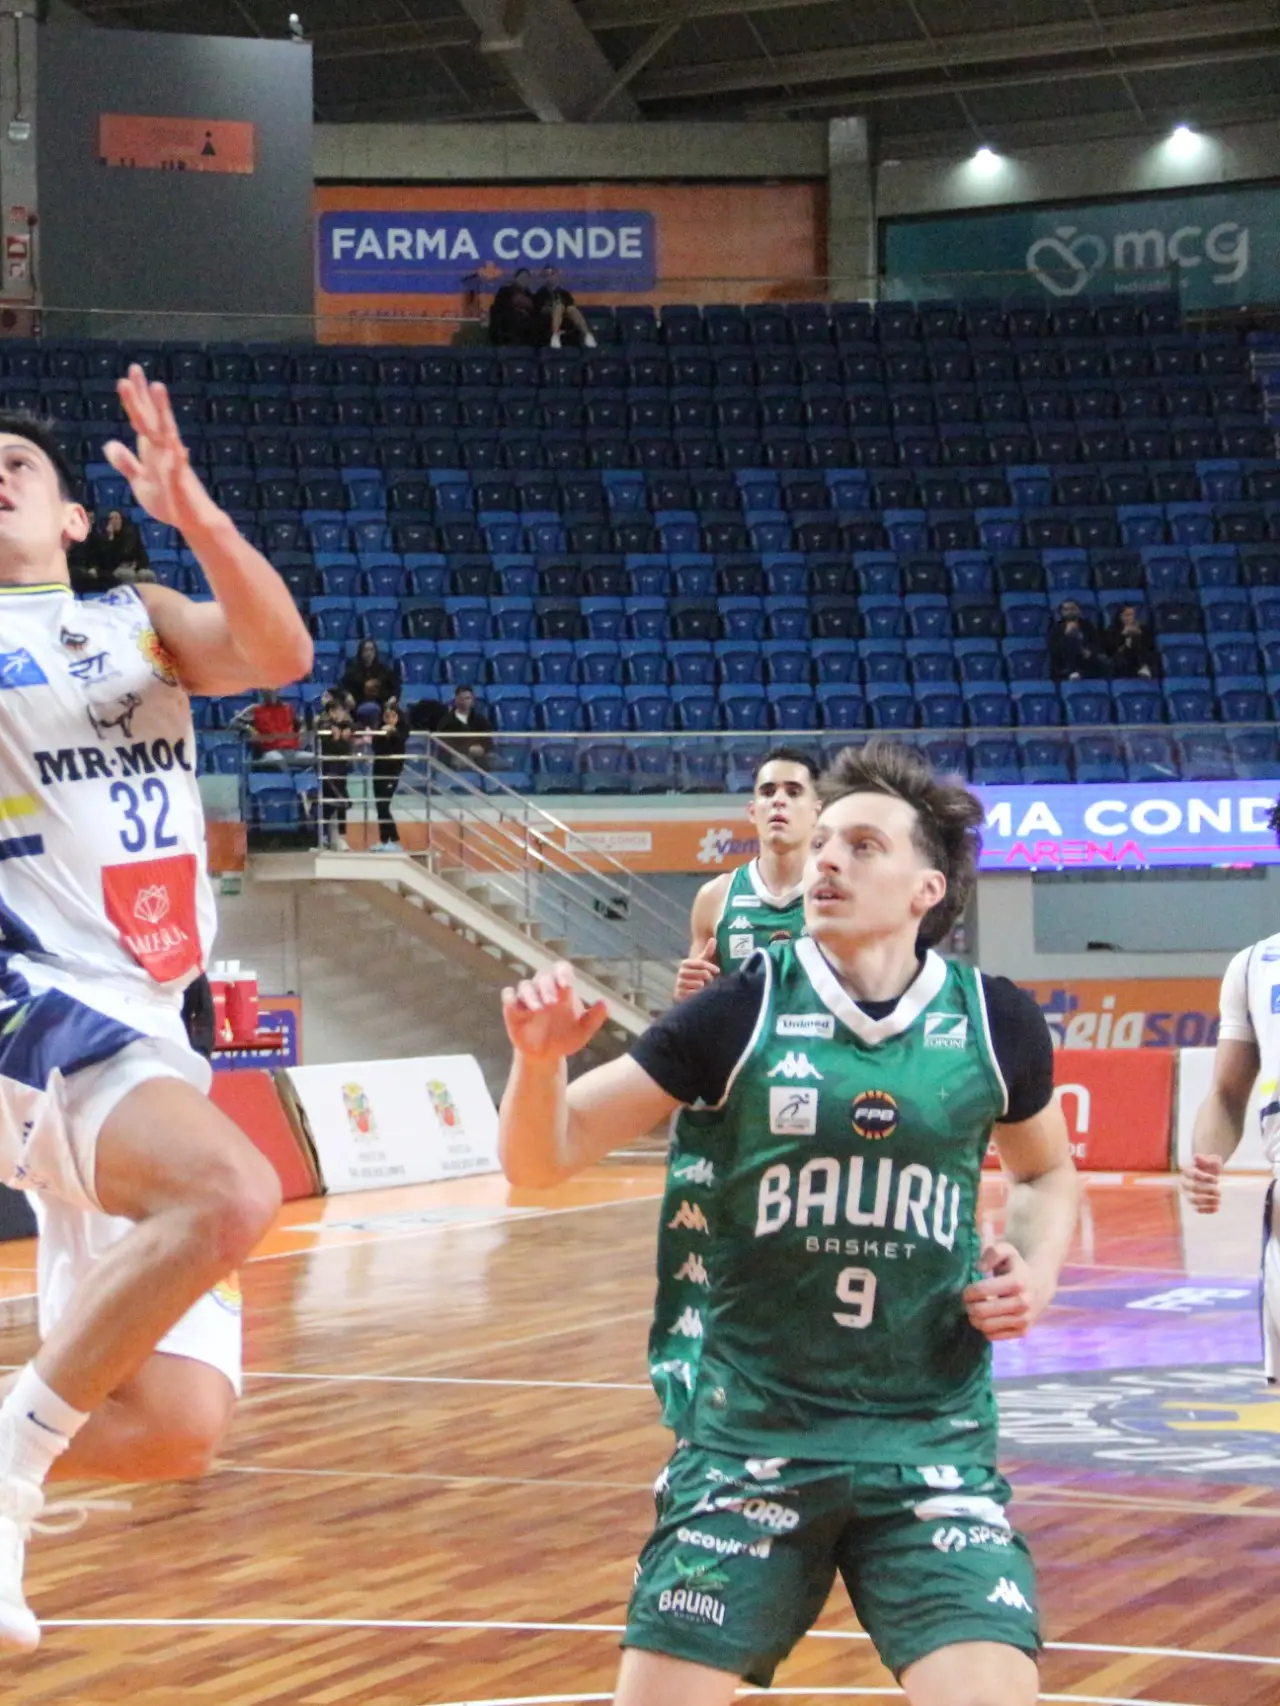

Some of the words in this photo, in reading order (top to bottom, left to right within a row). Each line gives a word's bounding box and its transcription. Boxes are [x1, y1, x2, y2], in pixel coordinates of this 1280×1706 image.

[332, 228, 480, 260] FARMA
[493, 227, 643, 259] CONDE
[1114, 222, 1250, 285] mcg
[109, 777, 178, 853] 32
[983, 801, 1063, 837] MA
[1084, 798, 1277, 836] COND
[1006, 840, 1146, 863] ARENA
[854, 1107, 895, 1122] FPB
[754, 1156, 960, 1253] BAURU
[805, 1235, 917, 1260] BASKET
[832, 1266, 877, 1330] 9
[658, 1588, 726, 1627] BAURU
